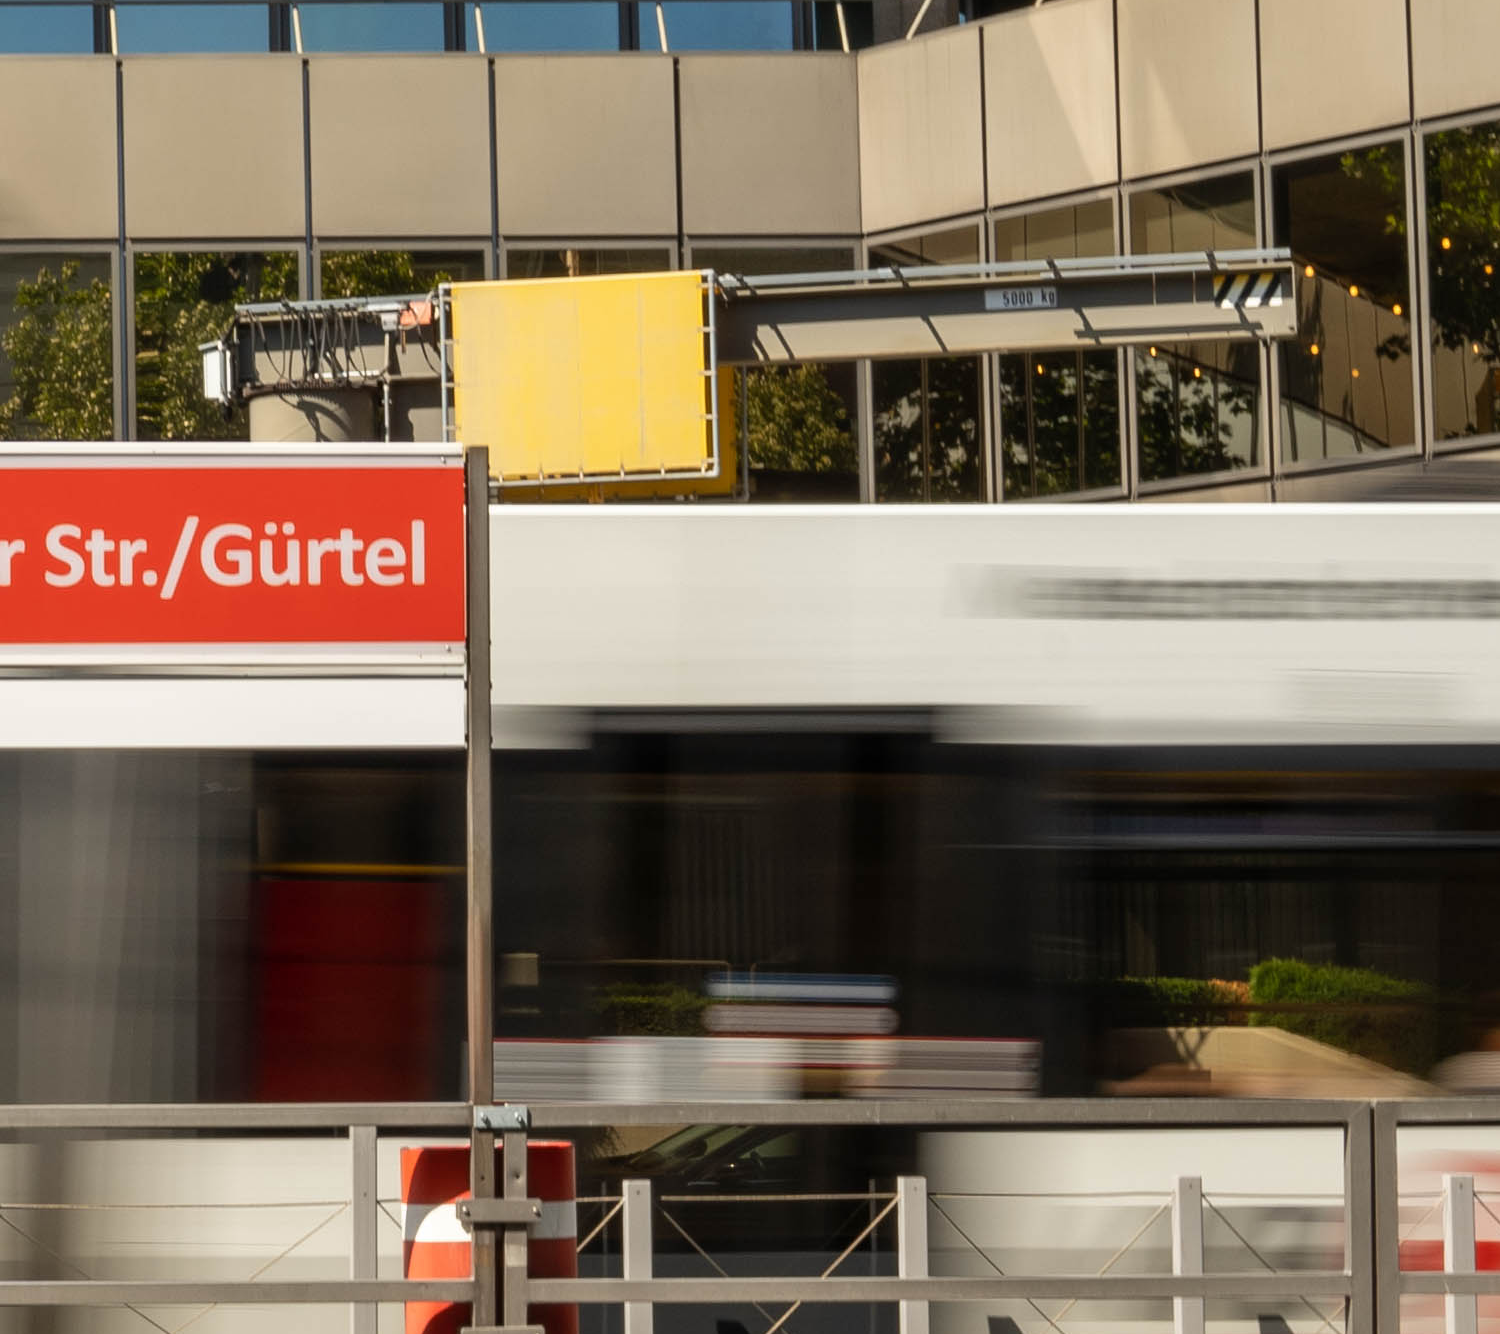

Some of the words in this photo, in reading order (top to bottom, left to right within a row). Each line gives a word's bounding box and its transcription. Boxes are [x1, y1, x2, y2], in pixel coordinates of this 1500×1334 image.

[1002, 290, 1034, 307] 5000
[1040, 286, 1056, 308] kg
[44, 515, 426, 600] Str./Gürtel
